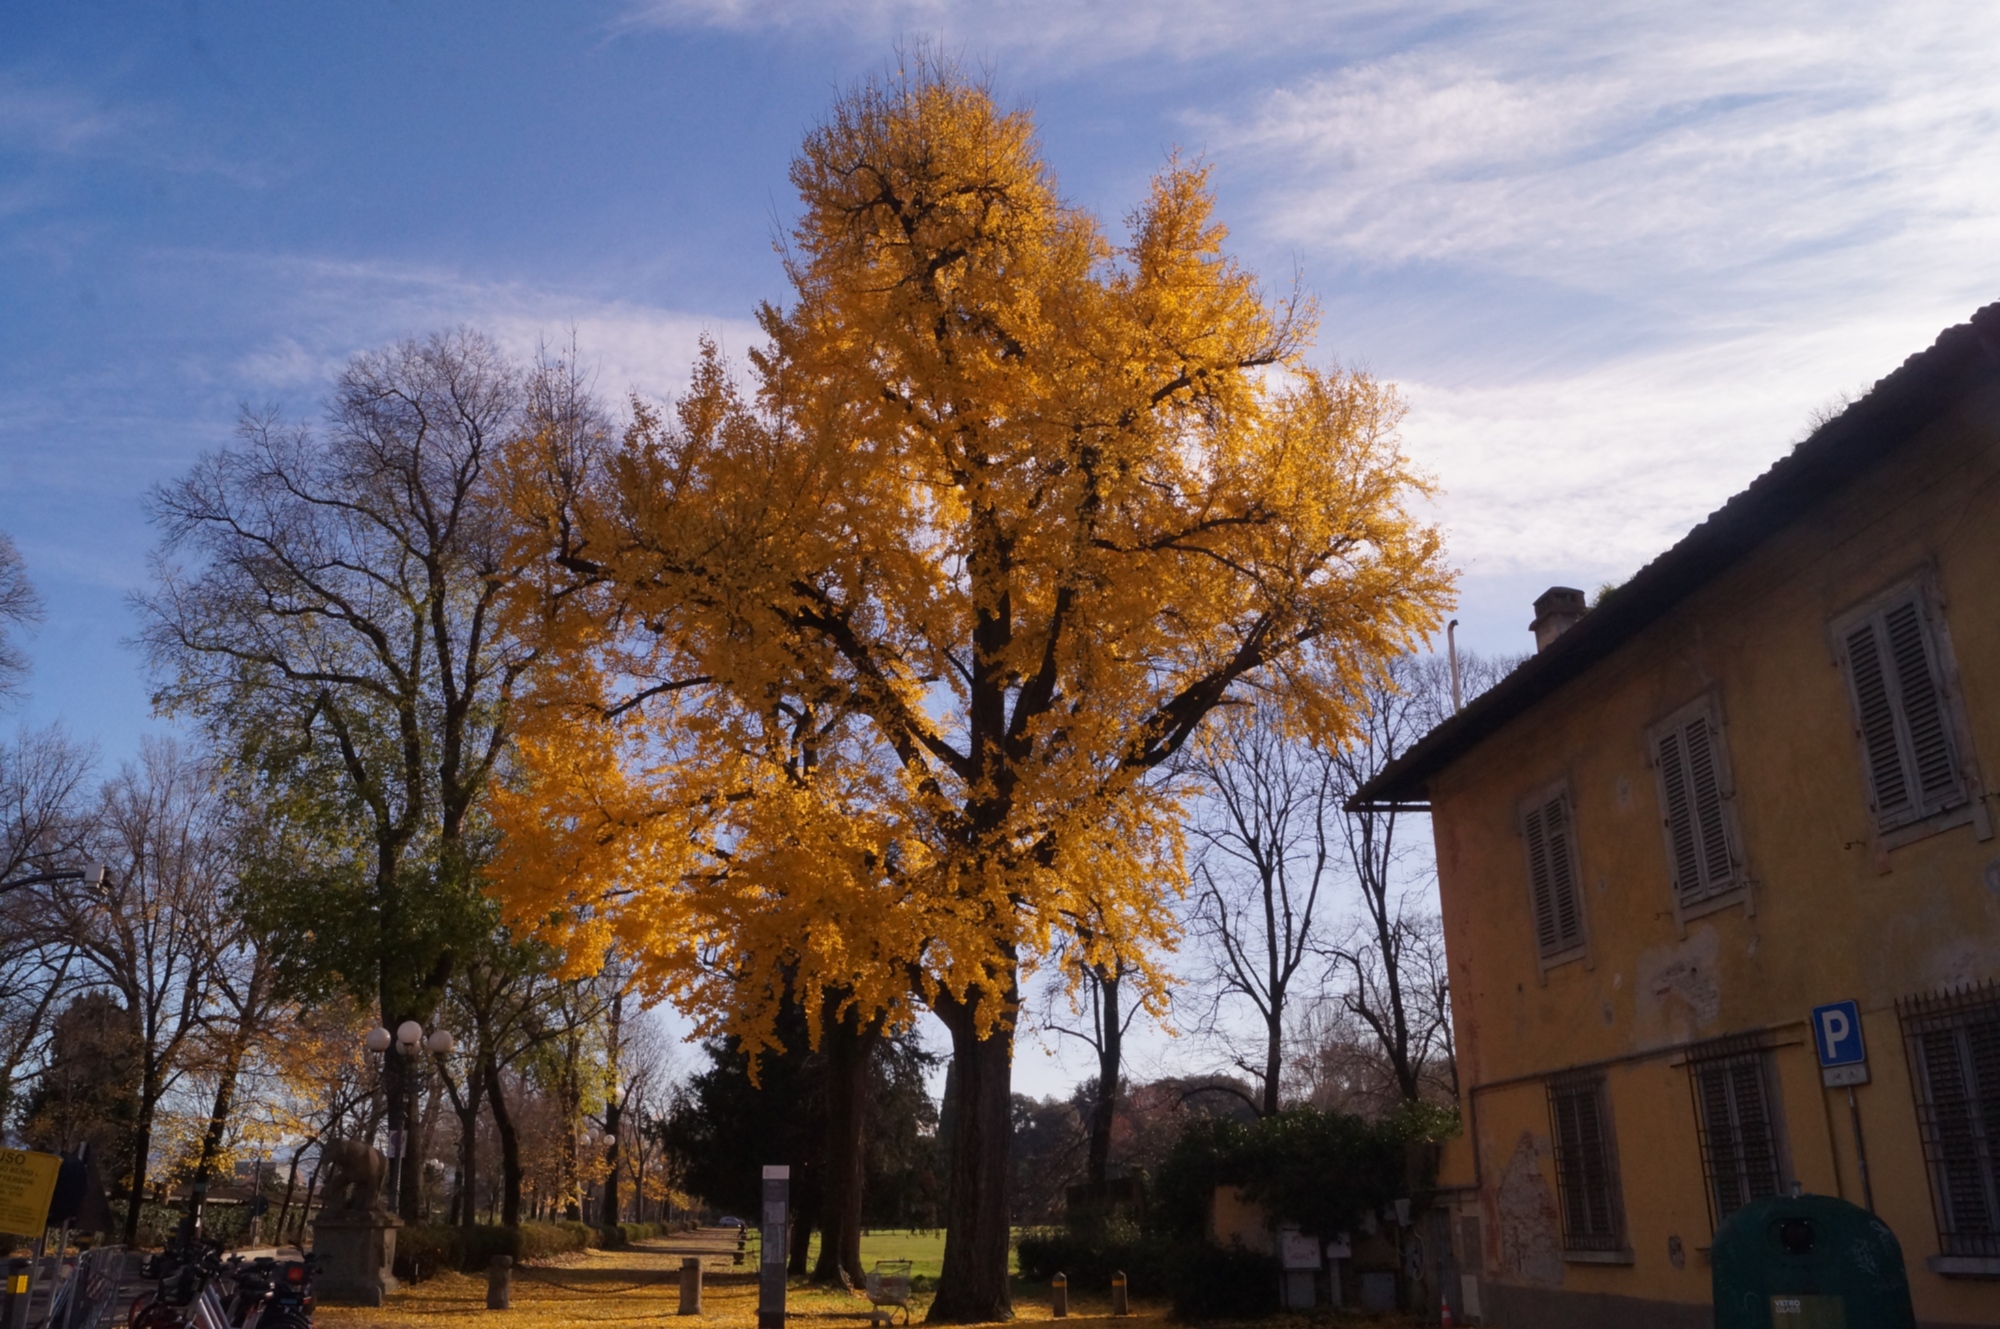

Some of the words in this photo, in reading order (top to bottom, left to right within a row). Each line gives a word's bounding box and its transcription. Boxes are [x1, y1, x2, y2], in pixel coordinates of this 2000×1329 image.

[1821, 1009, 1850, 1059] P
[1774, 1299, 1801, 1307] VETRO
[1775, 1306, 1801, 1314] GLASS
